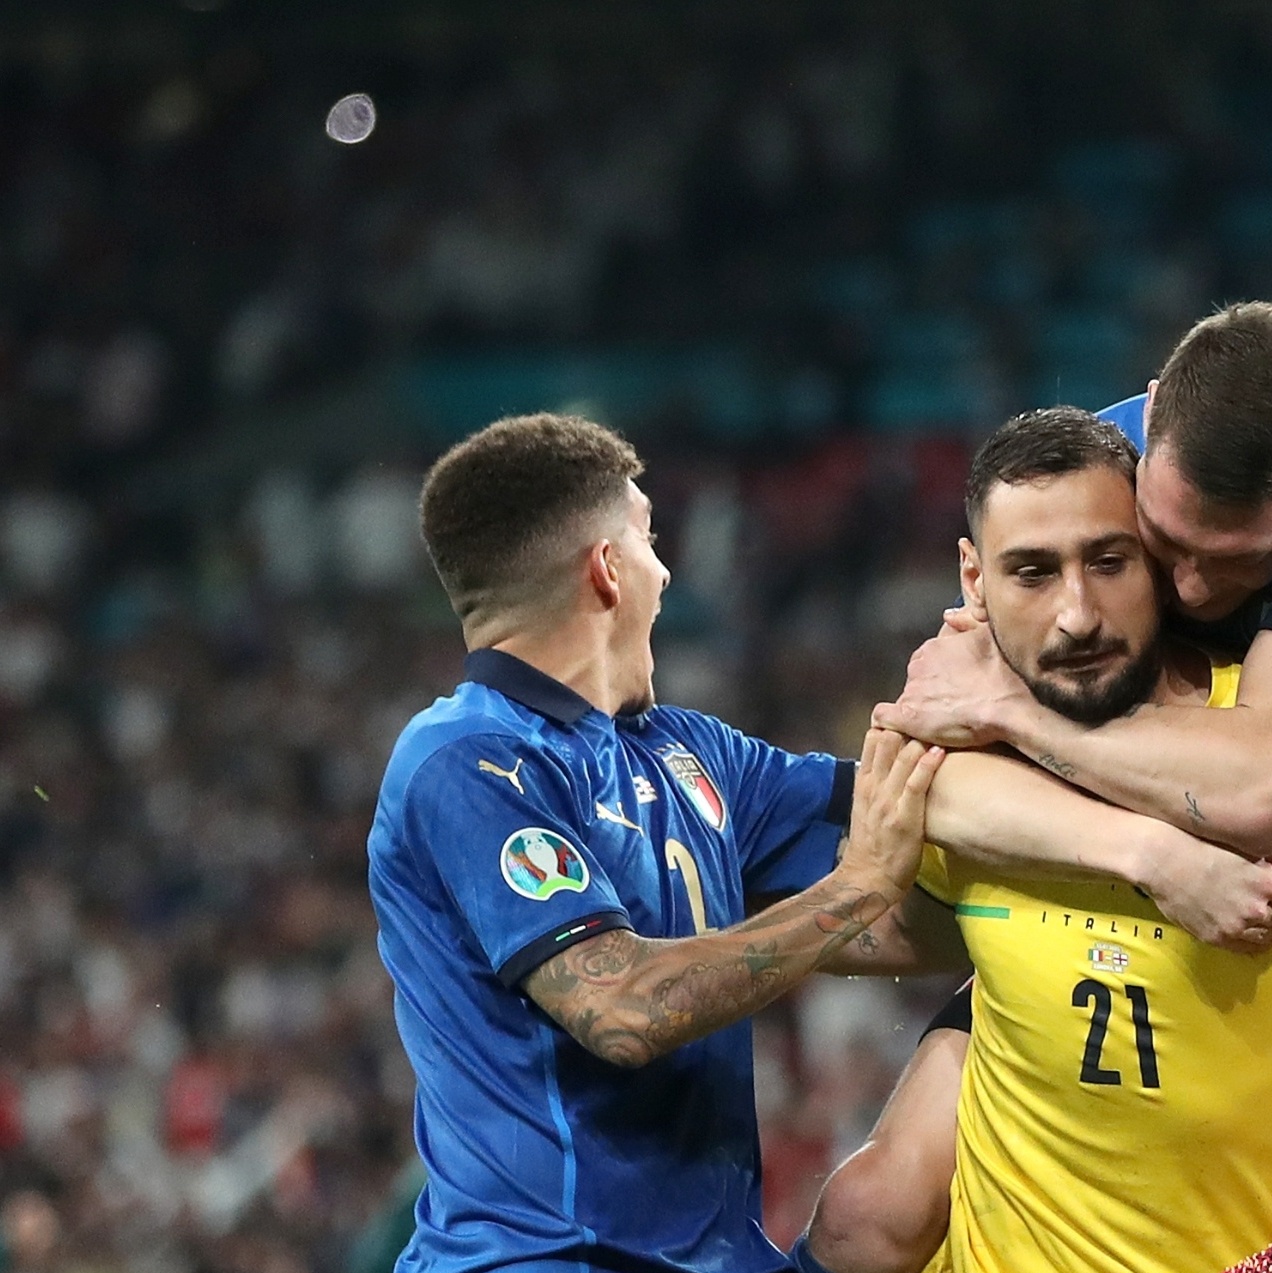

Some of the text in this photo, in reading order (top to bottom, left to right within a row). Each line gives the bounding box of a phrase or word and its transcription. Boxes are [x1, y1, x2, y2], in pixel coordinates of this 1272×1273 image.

[664, 838, 719, 936] 2
[1042, 911, 1163, 940] ITALIA
[1071, 978, 1160, 1089] 21
